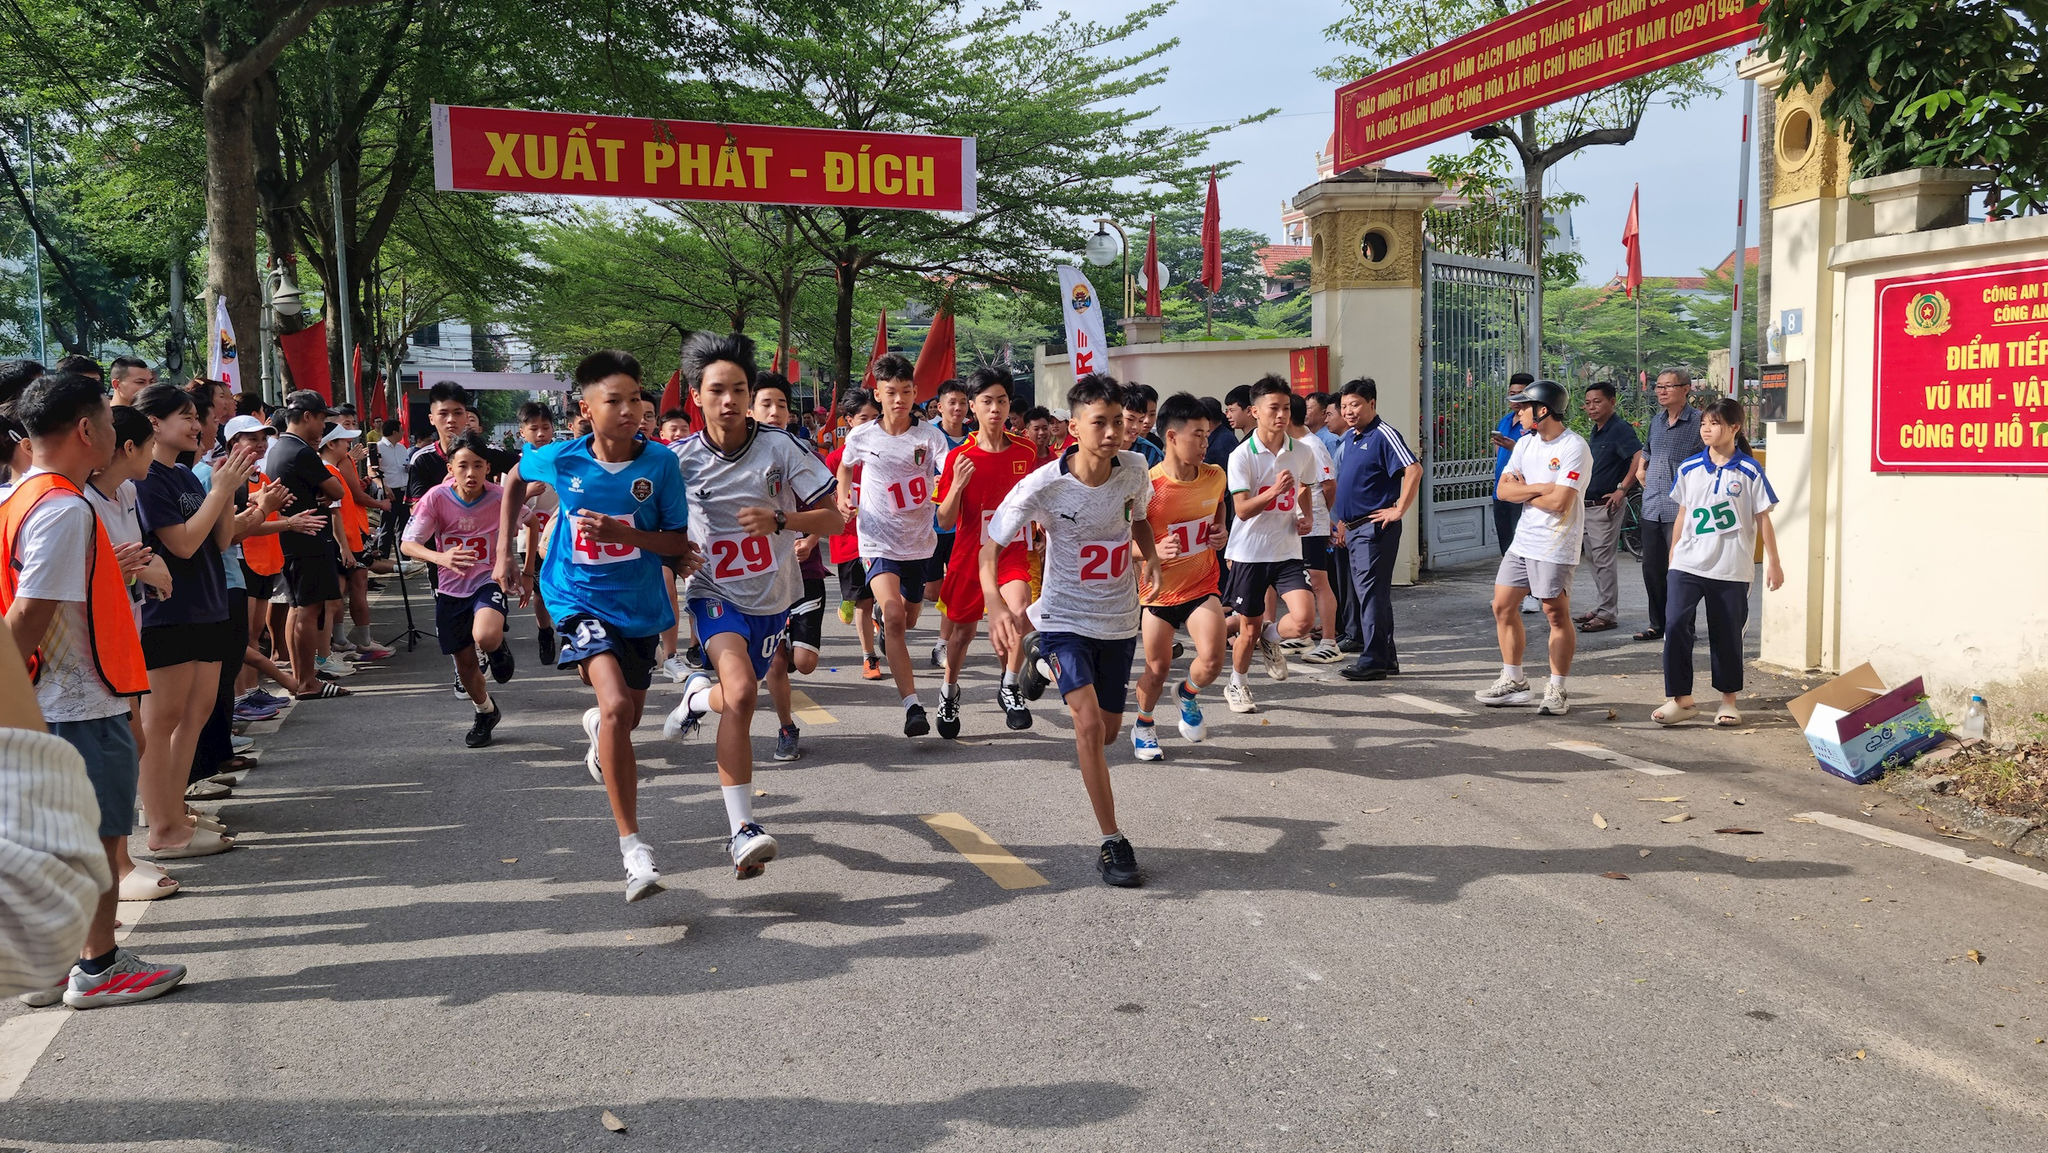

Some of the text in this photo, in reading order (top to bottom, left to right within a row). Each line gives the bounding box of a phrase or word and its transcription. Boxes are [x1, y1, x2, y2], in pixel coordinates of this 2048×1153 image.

[1416, 71, 1438, 97] NIỆM
[1440, 66, 1450, 87] 81
[1453, 56, 1475, 82] NĂM
[1477, 45, 1503, 72] CÁCH
[1506, 32, 1537, 62] MẠNG
[1539, 17, 1575, 48] THÁNG
[1578, 5, 1603, 34] TÁM
[1377, 111, 1398, 140] QUỐC
[1400, 104, 1428, 131] KHÁNH
[1430, 93, 1454, 120] NƯỚC
[1457, 84, 1482, 112] CỘNG
[1485, 74, 1504, 101] HÒA
[1506, 66, 1520, 93] XÃ
[1523, 60, 1540, 88] HỘI
[1544, 47, 1565, 80] CHỦ
[1568, 37, 1603, 71] NGHĨA
[1607, 27, 1633, 59] VIỆT
[1636, 17, 1666, 48] NAM
[485, 121, 625, 183] XUẤT
[643, 136, 774, 189] PHÁT
[790, 168, 808, 178] -
[823, 144, 935, 197] ĐÍCH
[1983, 285, 2017, 303] CÔNG
[2020, 283, 2039, 299] AN
[1788, 313, 1796, 331] 8
[1993, 303, 2048, 322] CÔNG AN
[1947, 333, 2000, 371] ĐIỂM
[1925, 380, 1950, 410] VŨ
[1957, 378, 1992, 408] KHÍ
[1900, 419, 1954, 449] CÔNG
[1960, 423, 1990, 453] CỤ
[1994, 413, 2023, 448] HỖ
[888, 476, 927, 509] 19
[1692, 501, 1737, 535] 25
[711, 535, 773, 579] 29
[1080, 541, 1130, 581] 20
